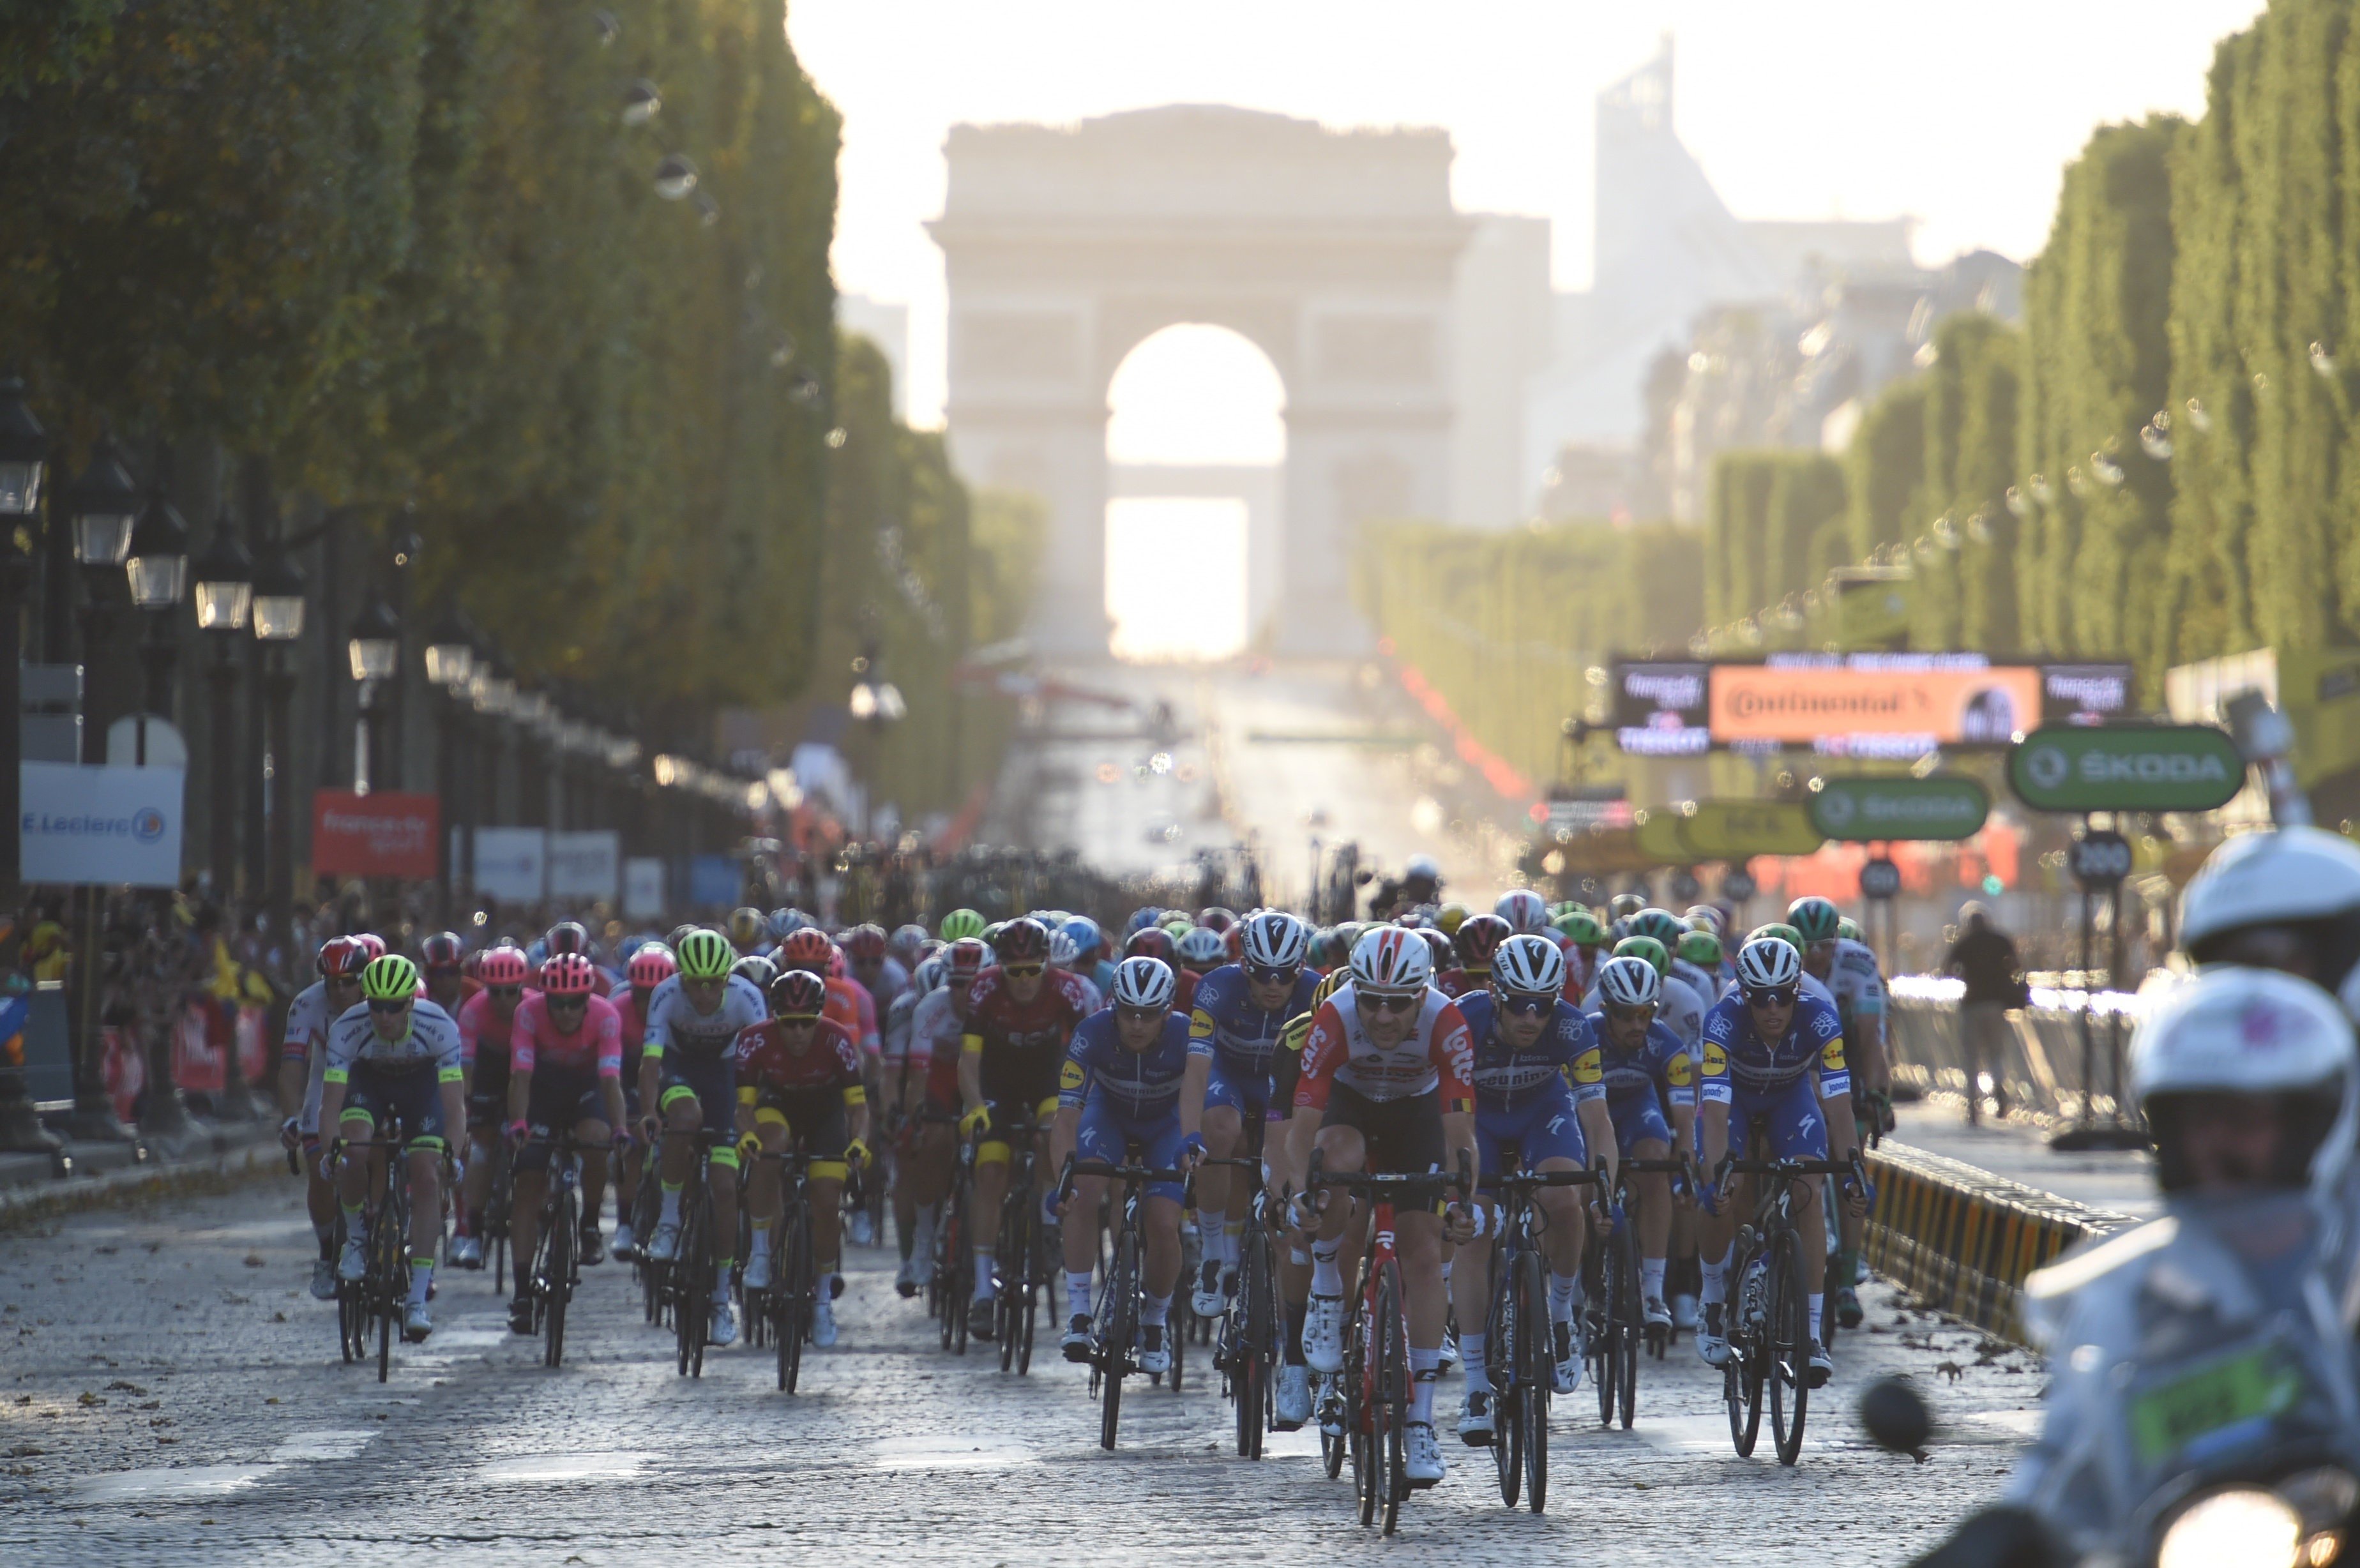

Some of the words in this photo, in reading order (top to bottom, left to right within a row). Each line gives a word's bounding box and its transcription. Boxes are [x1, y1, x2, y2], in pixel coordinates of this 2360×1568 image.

[1727, 686, 1898, 720] Continental
[2078, 749, 2228, 783] ŠKODA
[1862, 794, 1977, 821] ŠKODA
[2077, 840, 2131, 877] 200
[1300, 1023, 1328, 1073] CAPS
[1557, 1026, 1584, 1042] PRO
[1441, 1023, 1474, 1086] lotto
